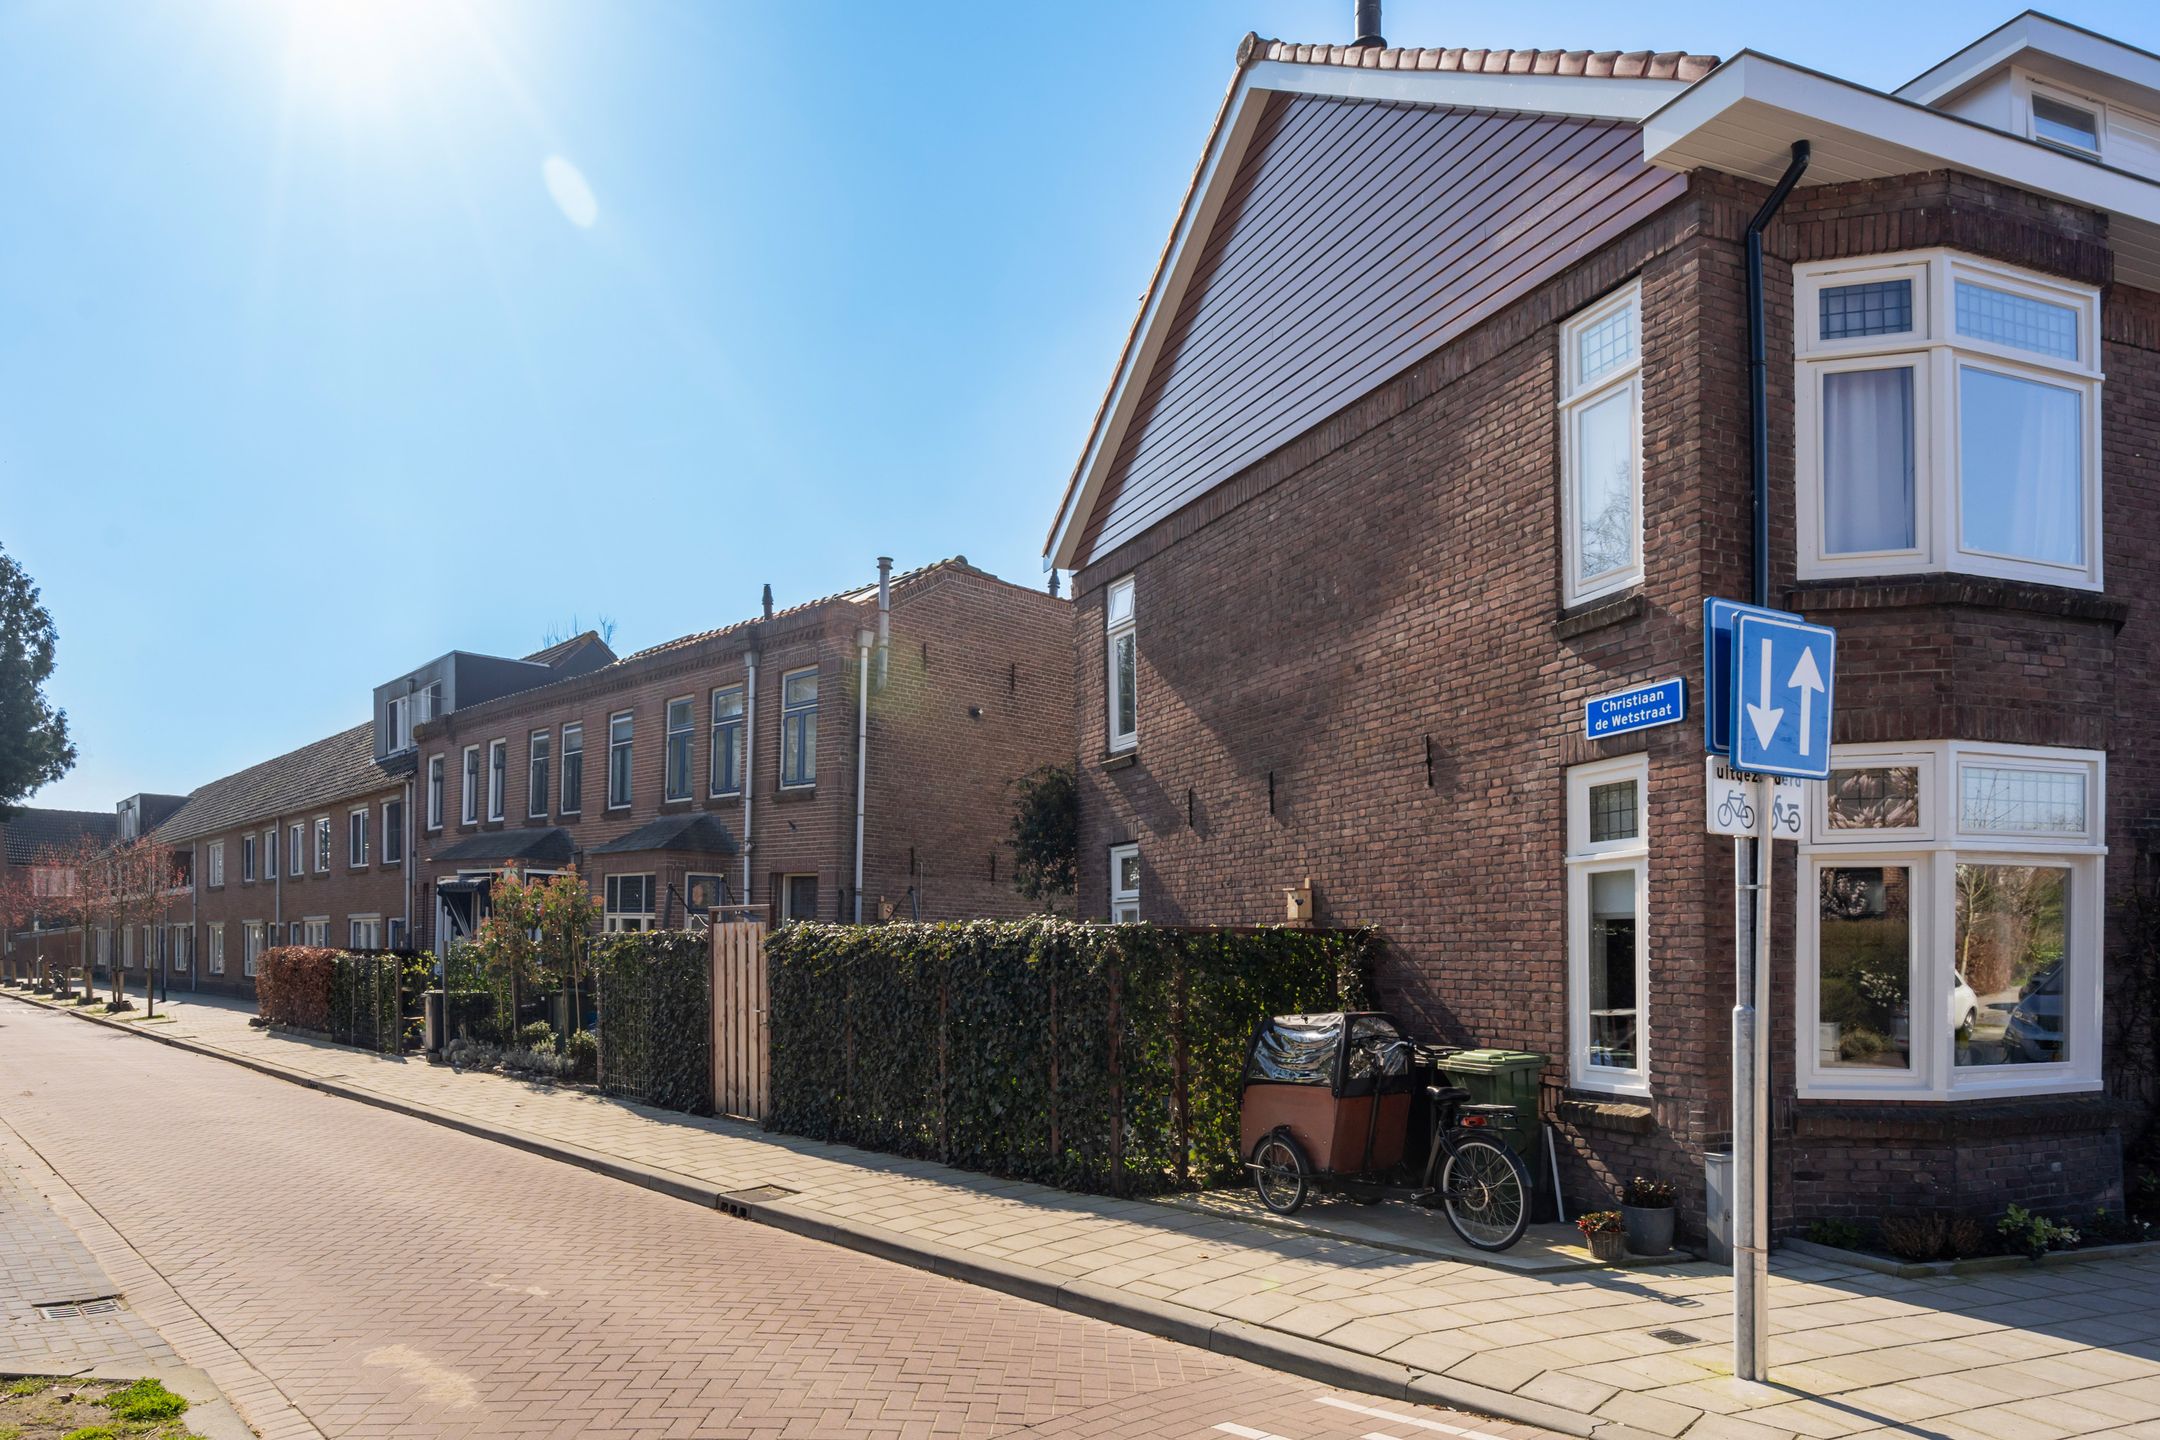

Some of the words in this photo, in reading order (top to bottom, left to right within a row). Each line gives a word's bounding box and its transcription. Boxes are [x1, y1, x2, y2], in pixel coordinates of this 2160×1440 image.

[1601, 690, 1664, 713] Christiaan
[1595, 718, 1609, 731] de
[1611, 703, 1672, 727] Wetstraat
